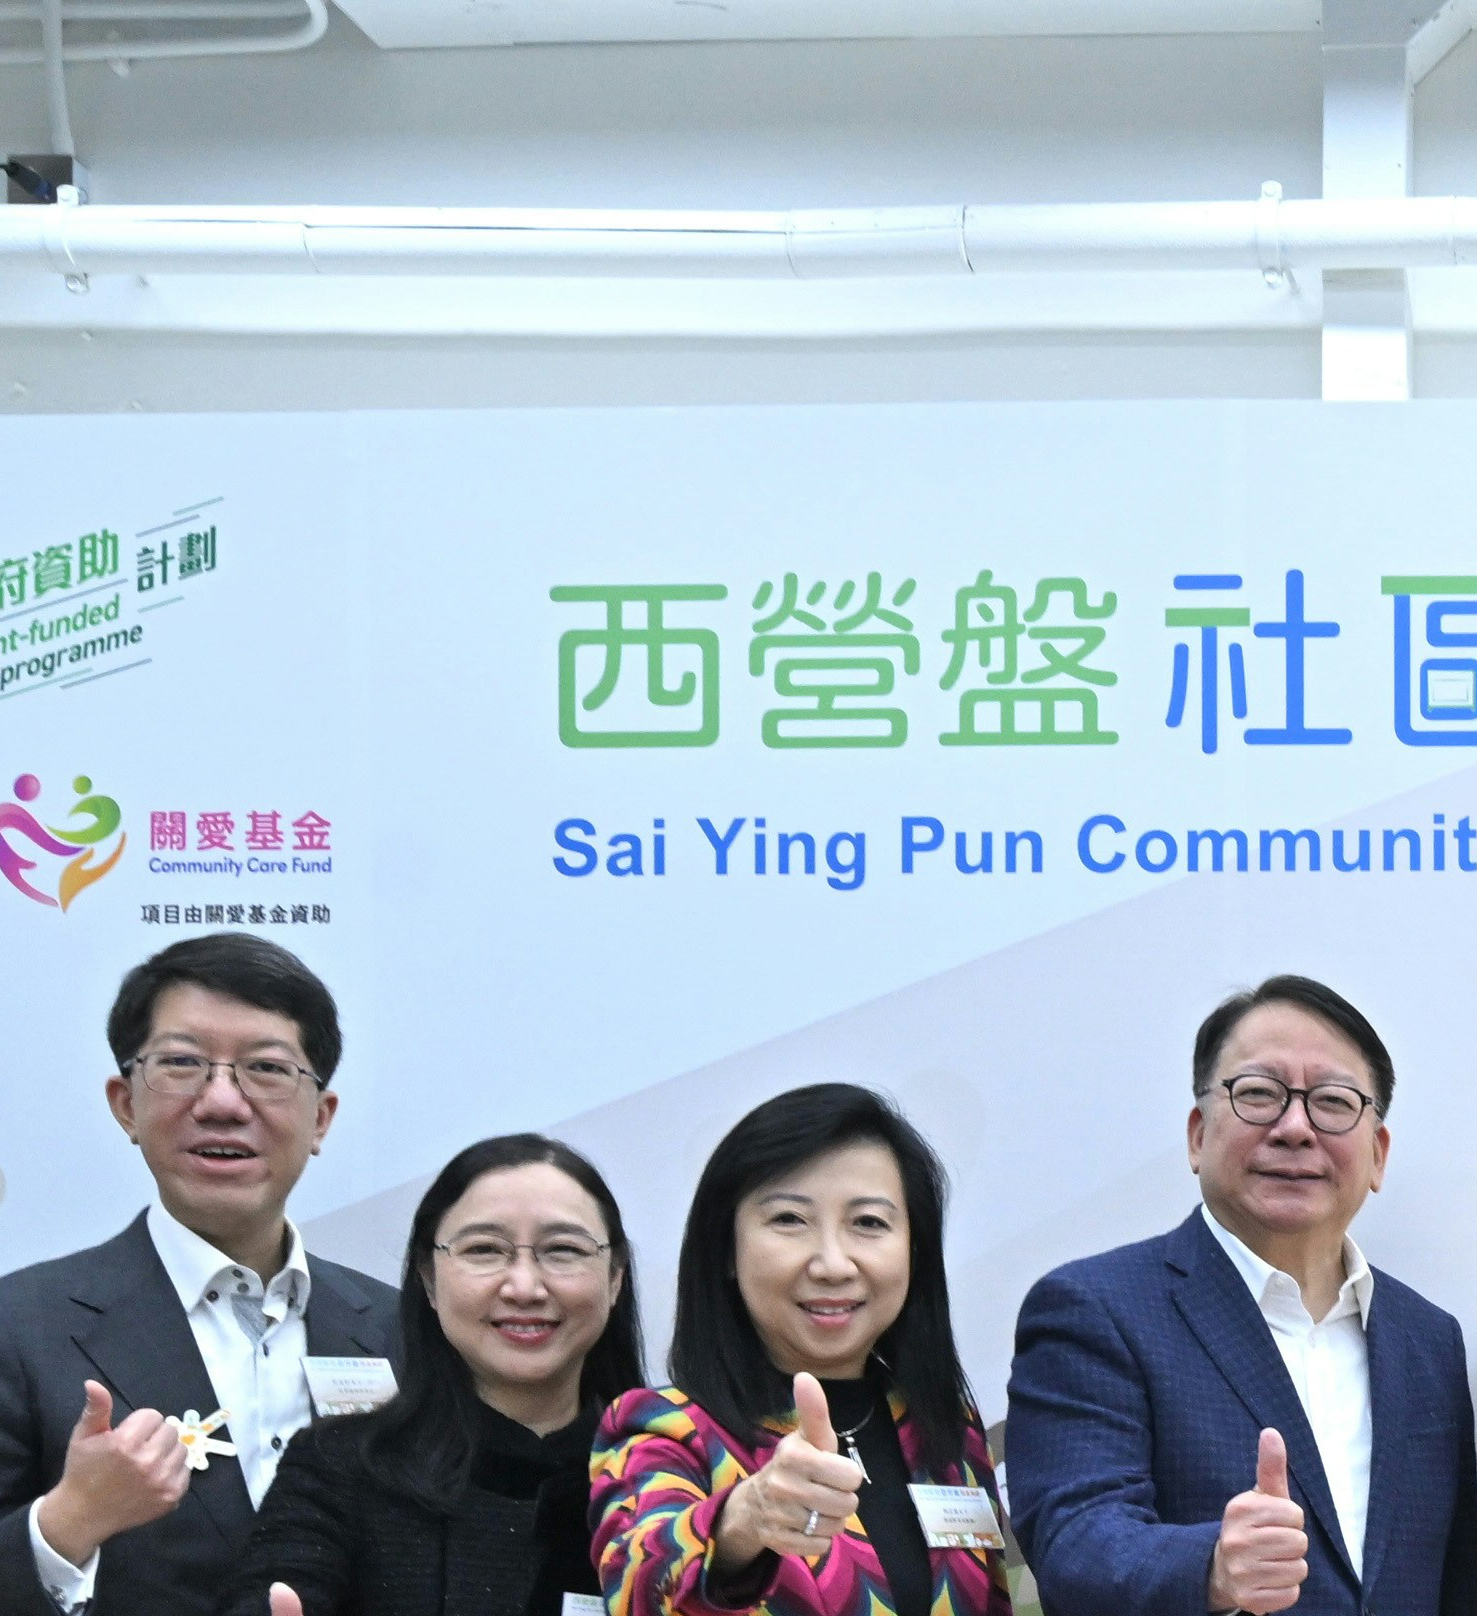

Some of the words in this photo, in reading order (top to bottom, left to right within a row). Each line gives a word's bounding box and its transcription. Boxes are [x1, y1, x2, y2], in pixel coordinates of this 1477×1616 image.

[150, 809, 332, 851] 關愛基金
[149, 857, 242, 877] Community
[247, 857, 287, 872] Care
[293, 857, 331, 872] Fund
[553, 818, 665, 877] Sai
[696, 818, 865, 890] Ying
[902, 816, 1043, 874] Pun
[142, 905, 330, 923] 項目由關愛基金資助
